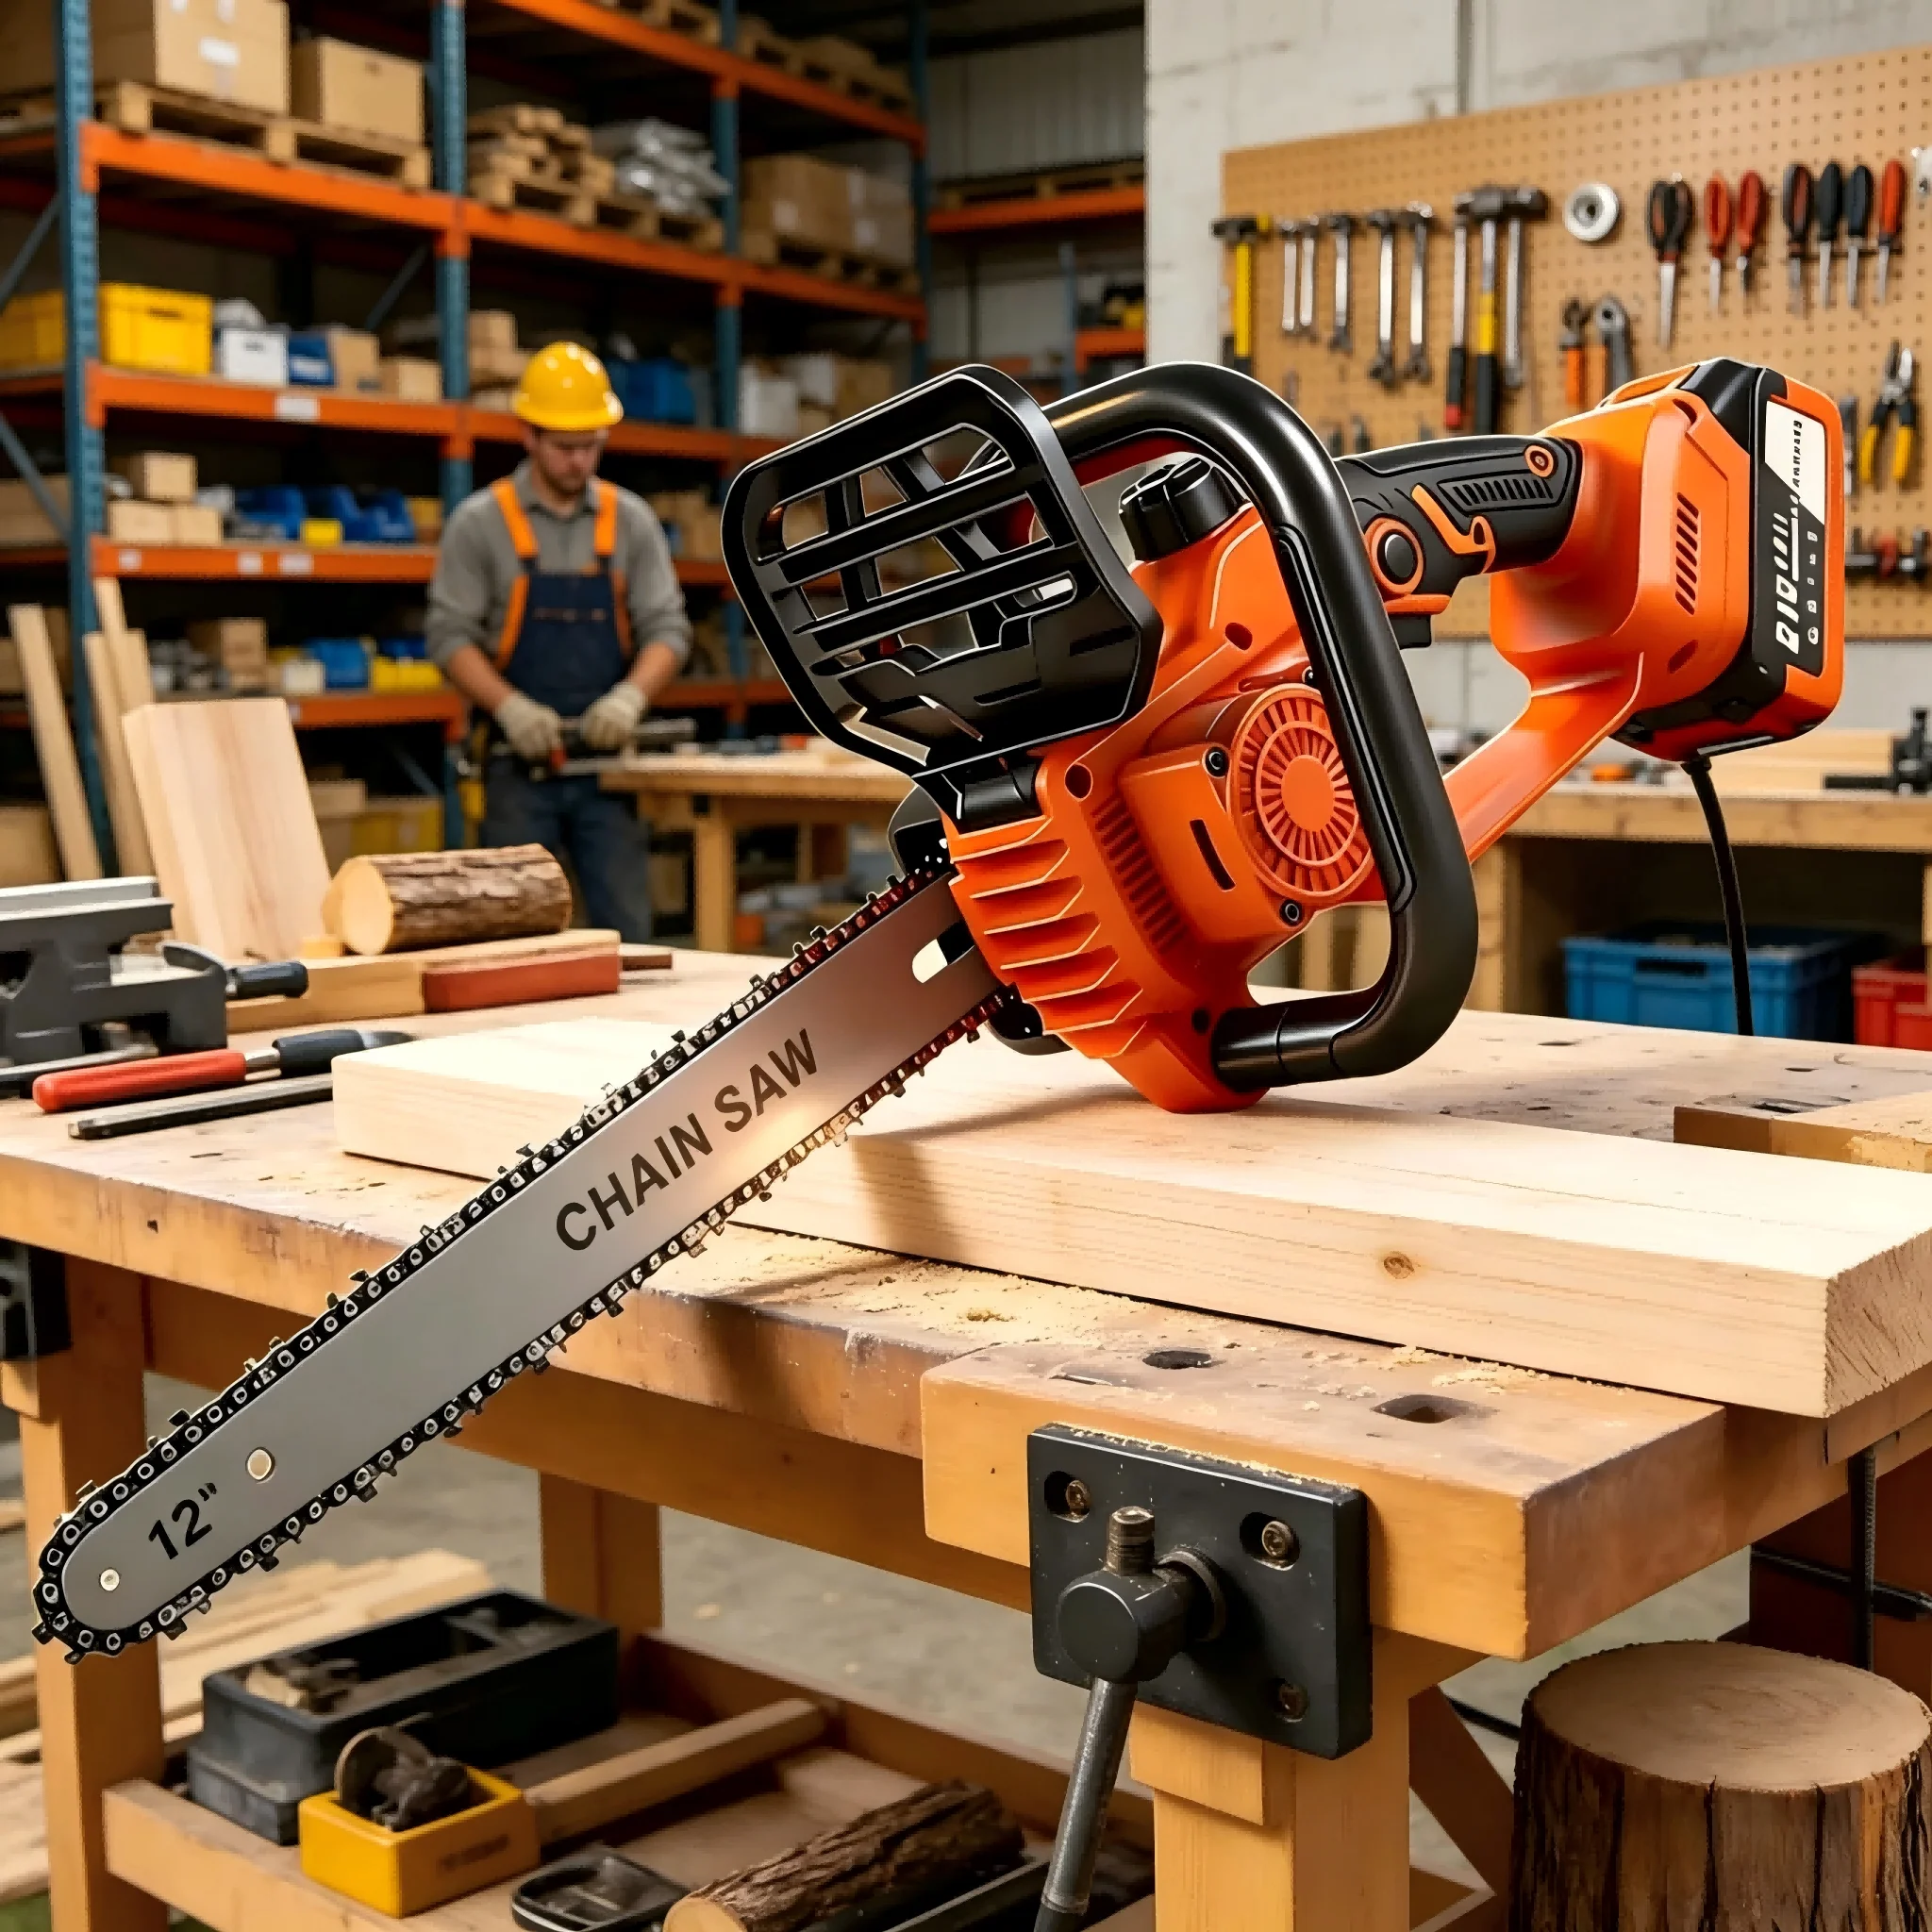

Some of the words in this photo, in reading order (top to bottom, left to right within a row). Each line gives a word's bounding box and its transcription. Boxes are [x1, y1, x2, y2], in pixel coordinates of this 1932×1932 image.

[556, 1112, 713, 1251] CHAIN
[714, 1027, 818, 1133] SAW
[148, 1482, 218, 1560] 12"
